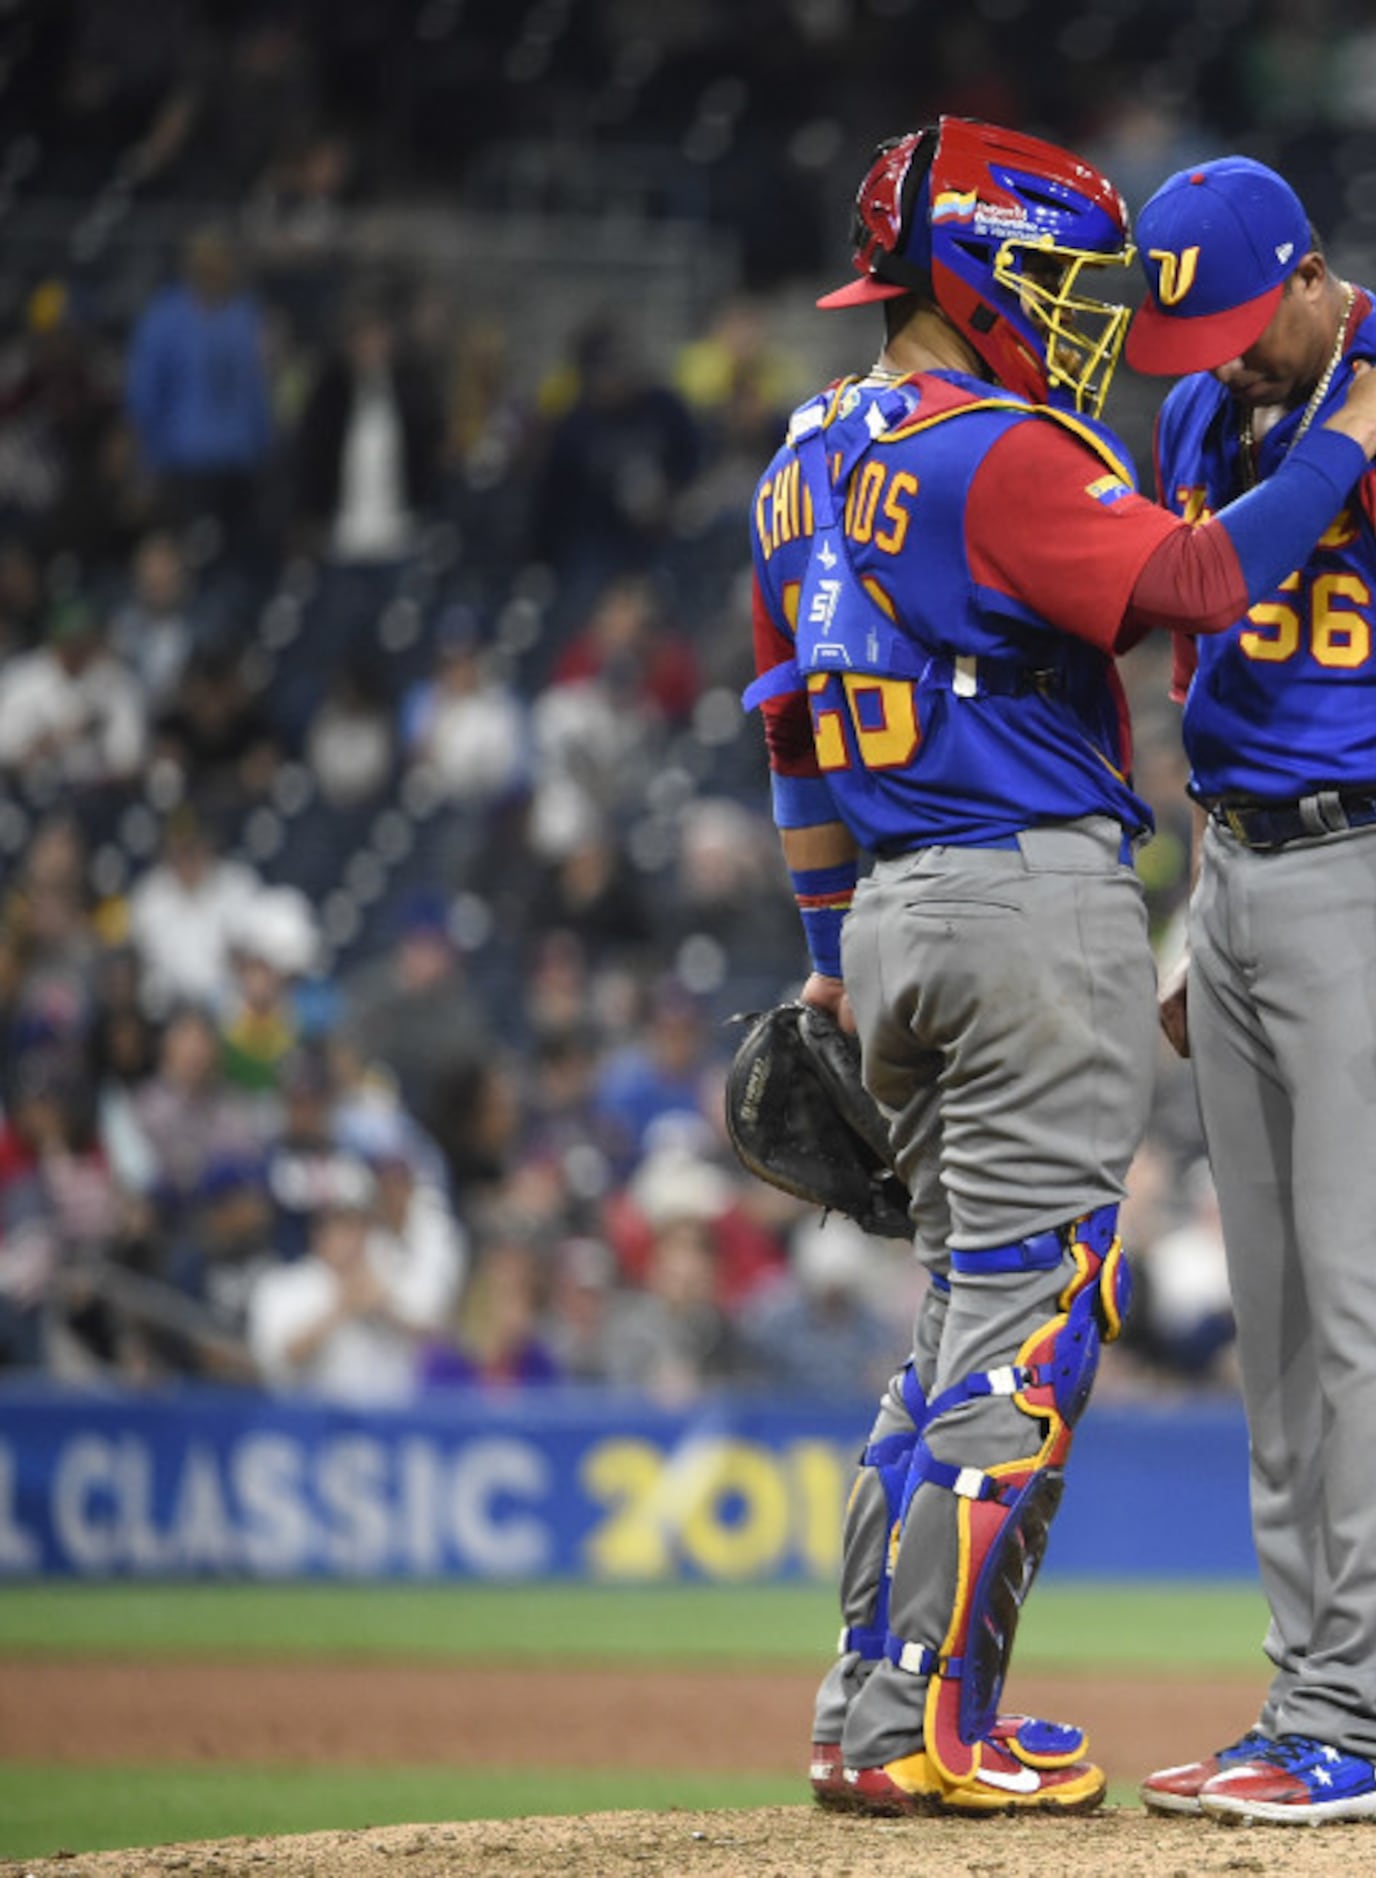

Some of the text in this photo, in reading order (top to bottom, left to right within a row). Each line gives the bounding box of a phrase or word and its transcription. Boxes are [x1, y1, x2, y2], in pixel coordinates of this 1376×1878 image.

[1239, 569, 1371, 668] 56
[52, 1428, 550, 1577] CLASSIC
[582, 1434, 845, 1582] 201
